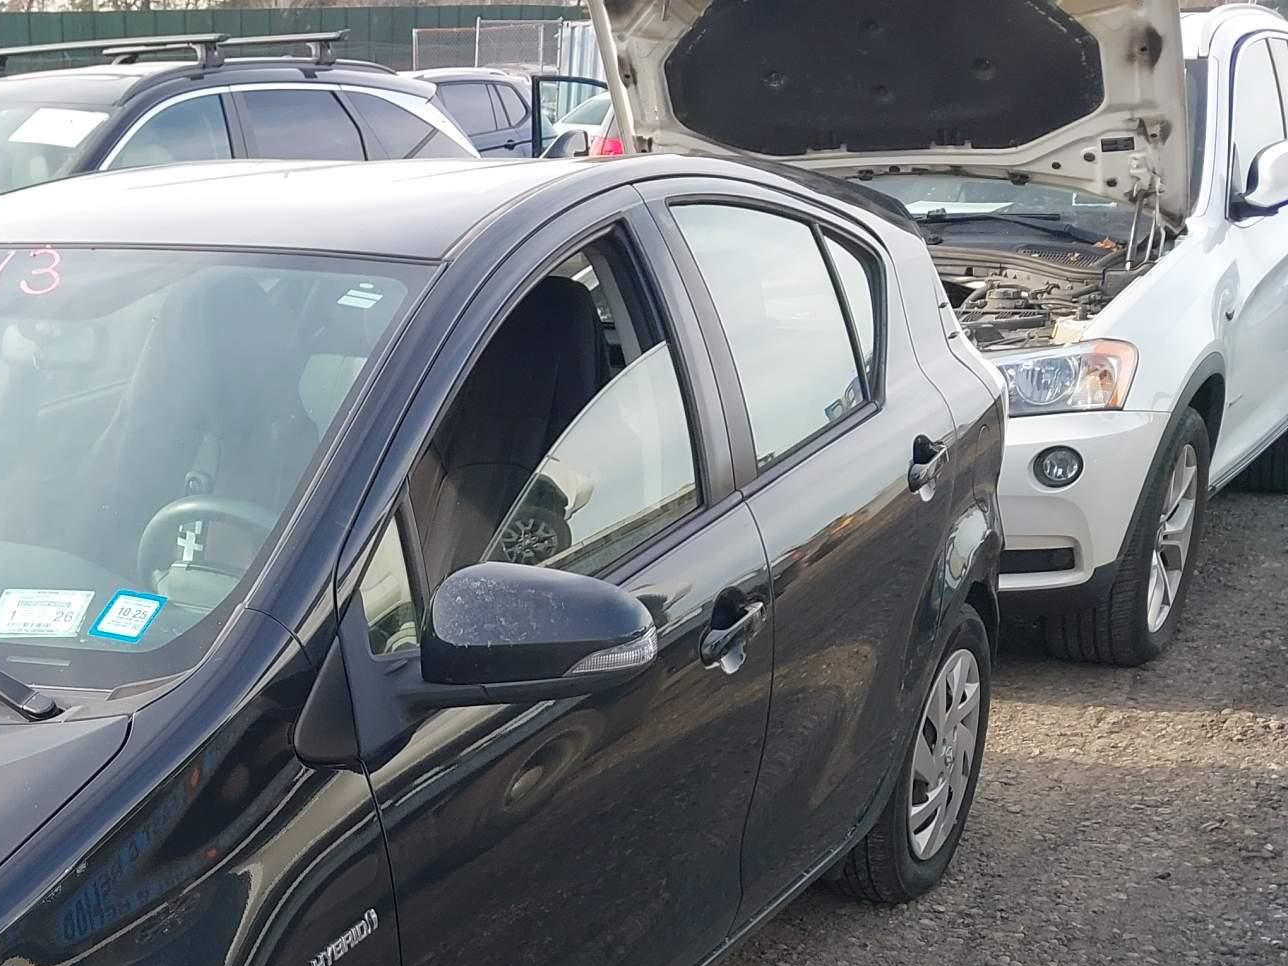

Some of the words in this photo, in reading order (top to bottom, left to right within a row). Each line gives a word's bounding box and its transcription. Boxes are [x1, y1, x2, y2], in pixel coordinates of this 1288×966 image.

[52, 610, 74, 623] 26
[117, 607, 132, 617] 10
[132, 609, 149, 620] 25
